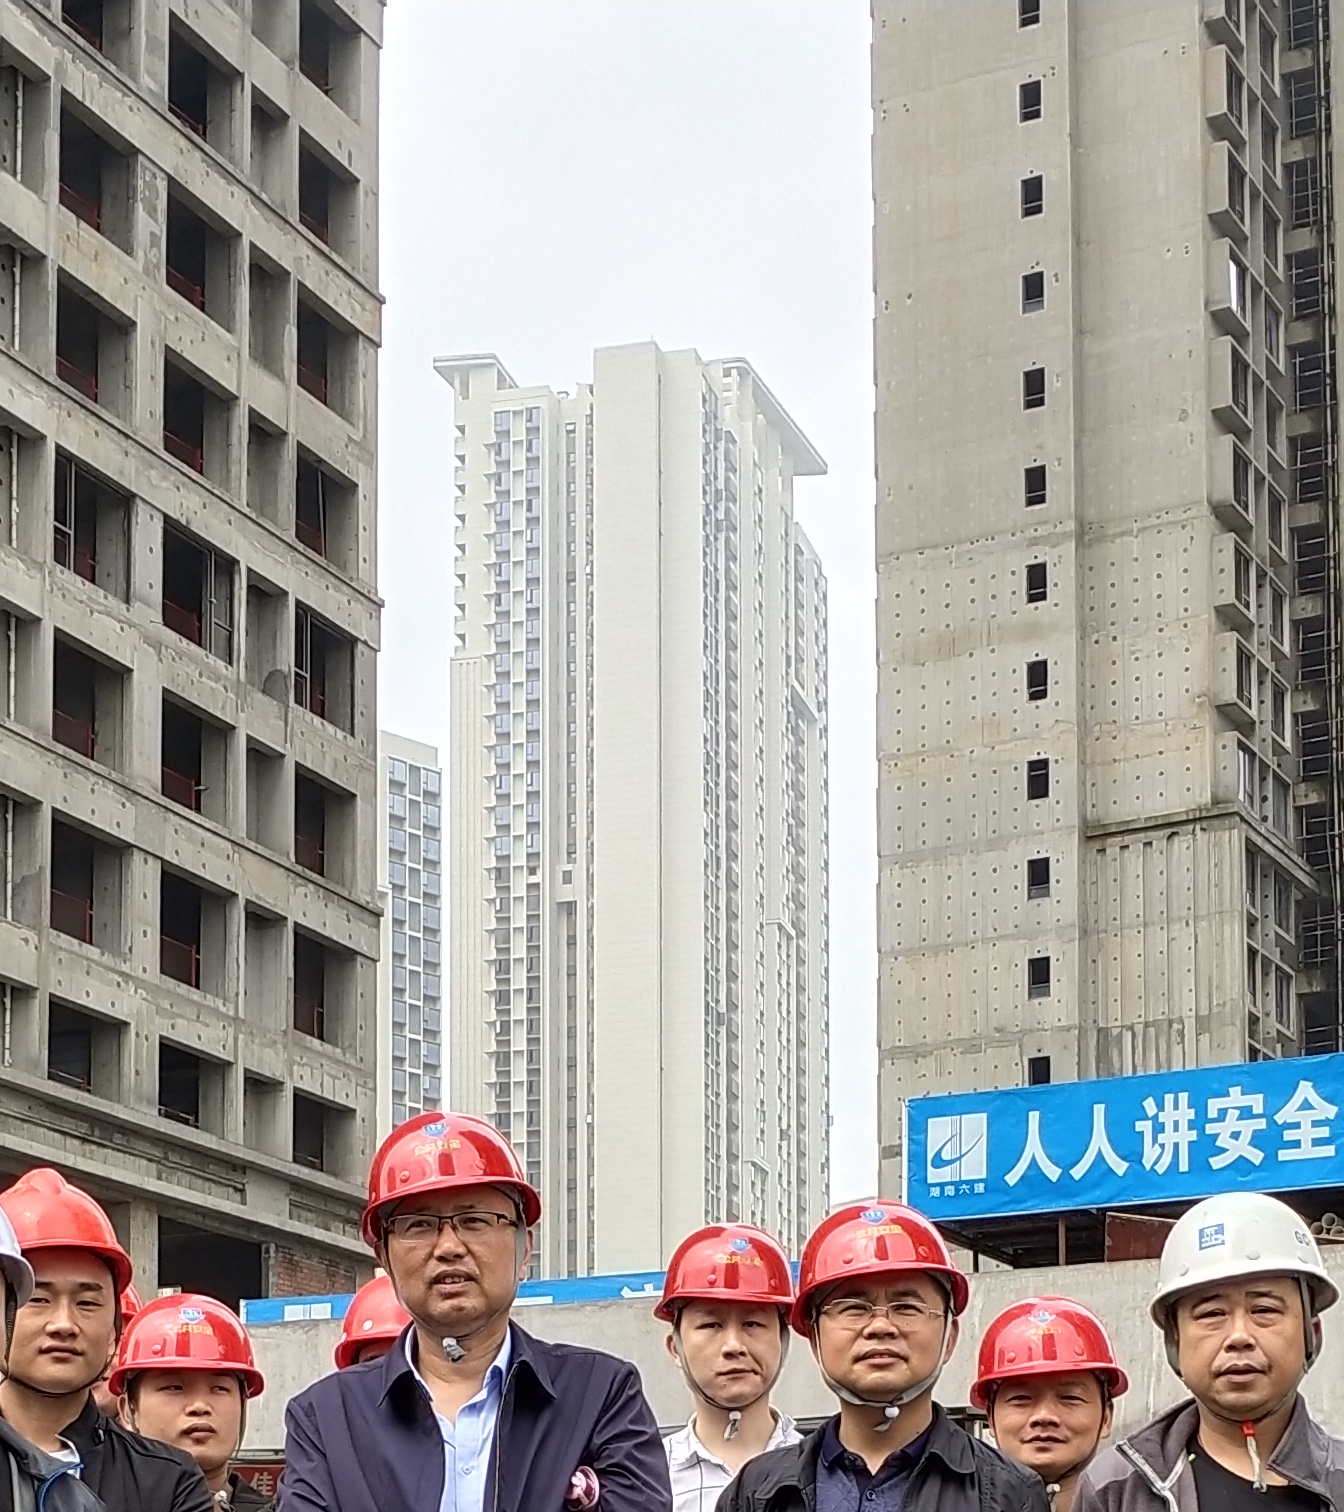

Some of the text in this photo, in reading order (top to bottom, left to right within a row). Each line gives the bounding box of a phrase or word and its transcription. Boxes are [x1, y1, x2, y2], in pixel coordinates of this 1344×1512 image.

[1003, 1079, 1340, 1190] 人人讲安全
[929, 1183, 986, 1198] 湖南六建
